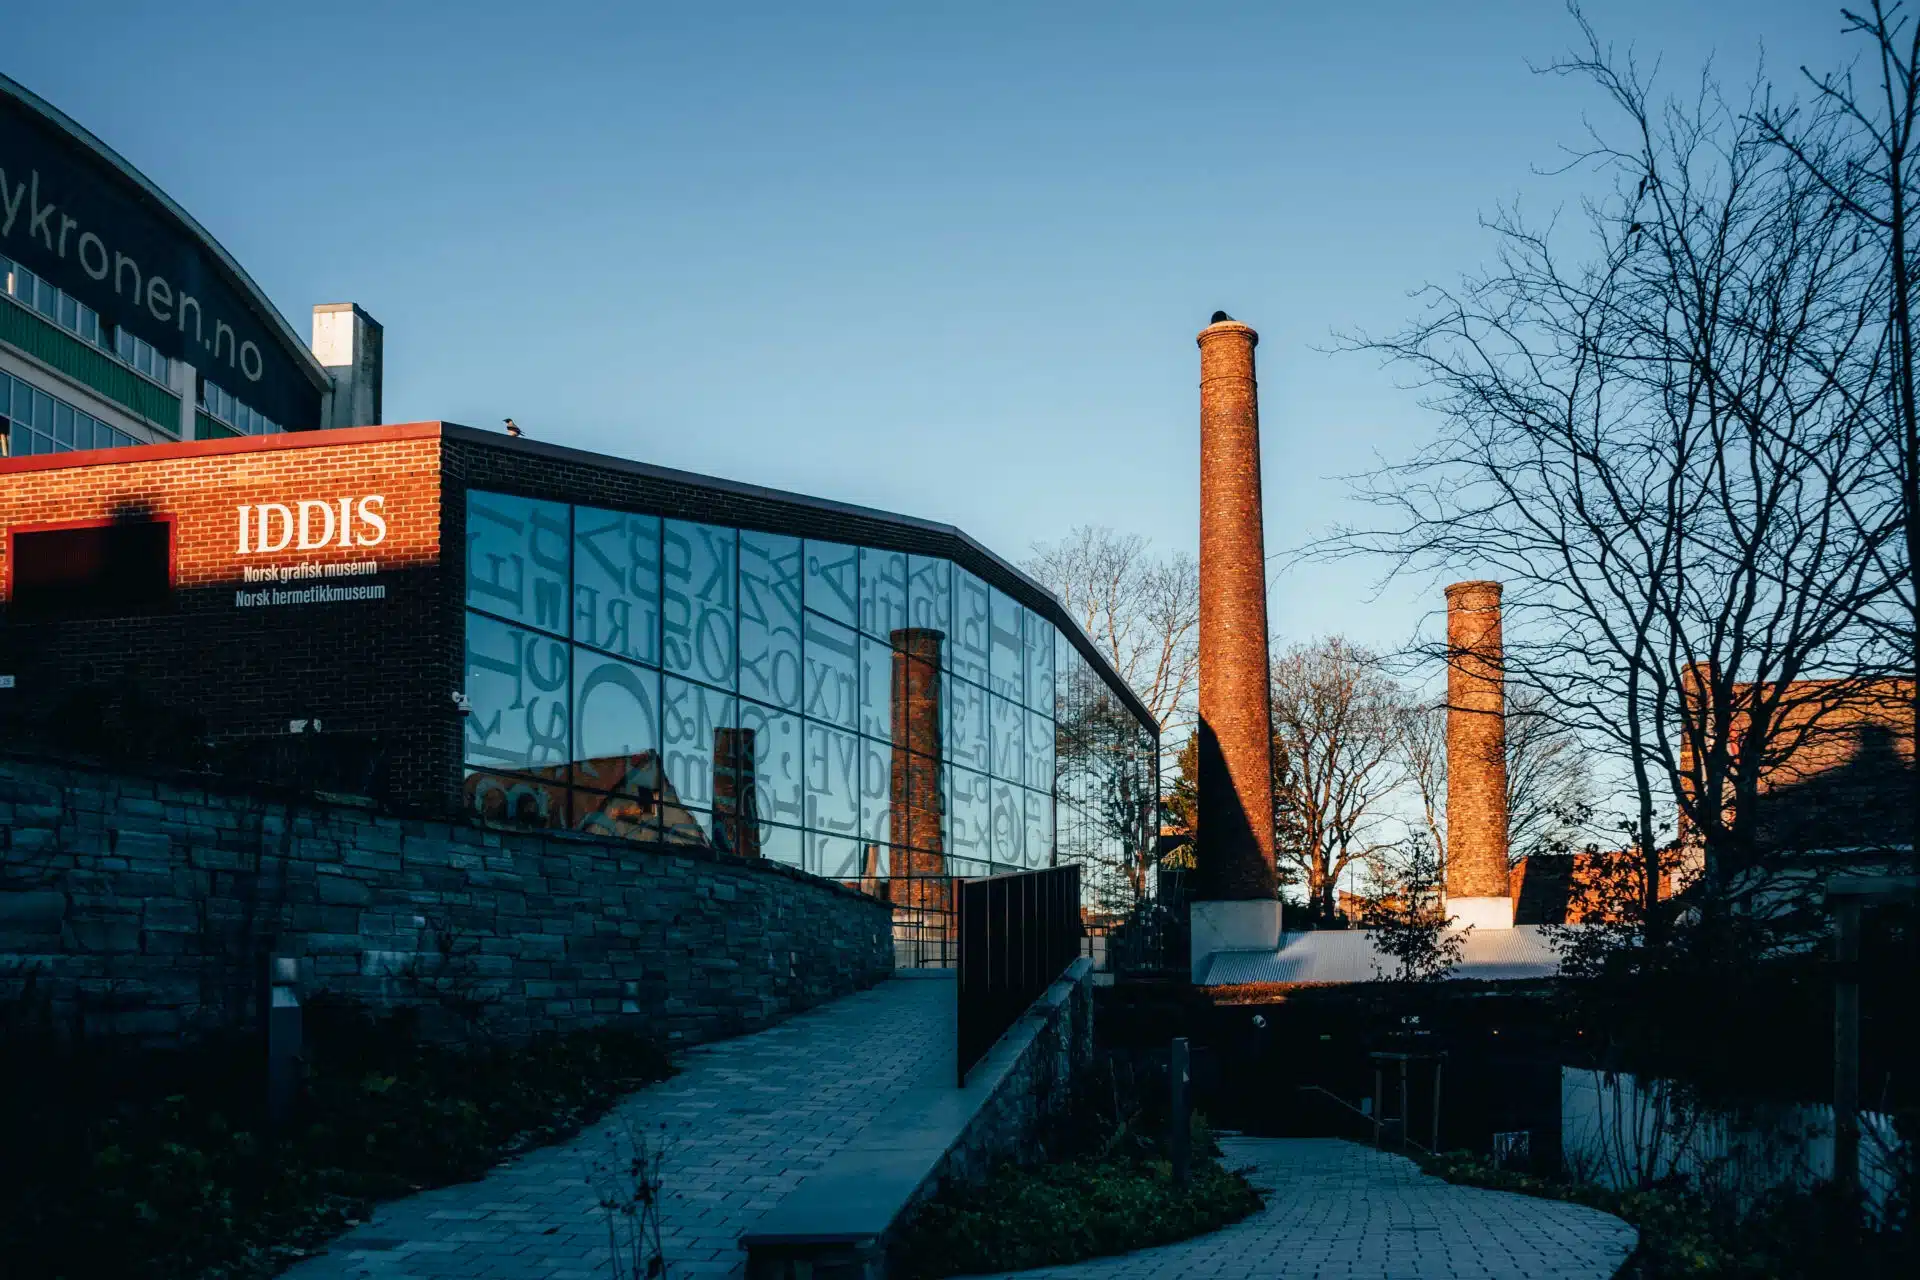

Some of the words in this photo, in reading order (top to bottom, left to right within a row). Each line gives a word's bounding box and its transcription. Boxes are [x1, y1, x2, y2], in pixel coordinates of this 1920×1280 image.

[0, 167, 263, 382] ykronen.no
[236, 495, 387, 555] IDDIS
[243, 563, 279, 583] Norsk
[280, 560, 323, 584] grafisk
[324, 560, 378, 577] museum
[235, 588, 270, 607] Norsk
[272, 584, 386, 605] hermetikkmuseum
